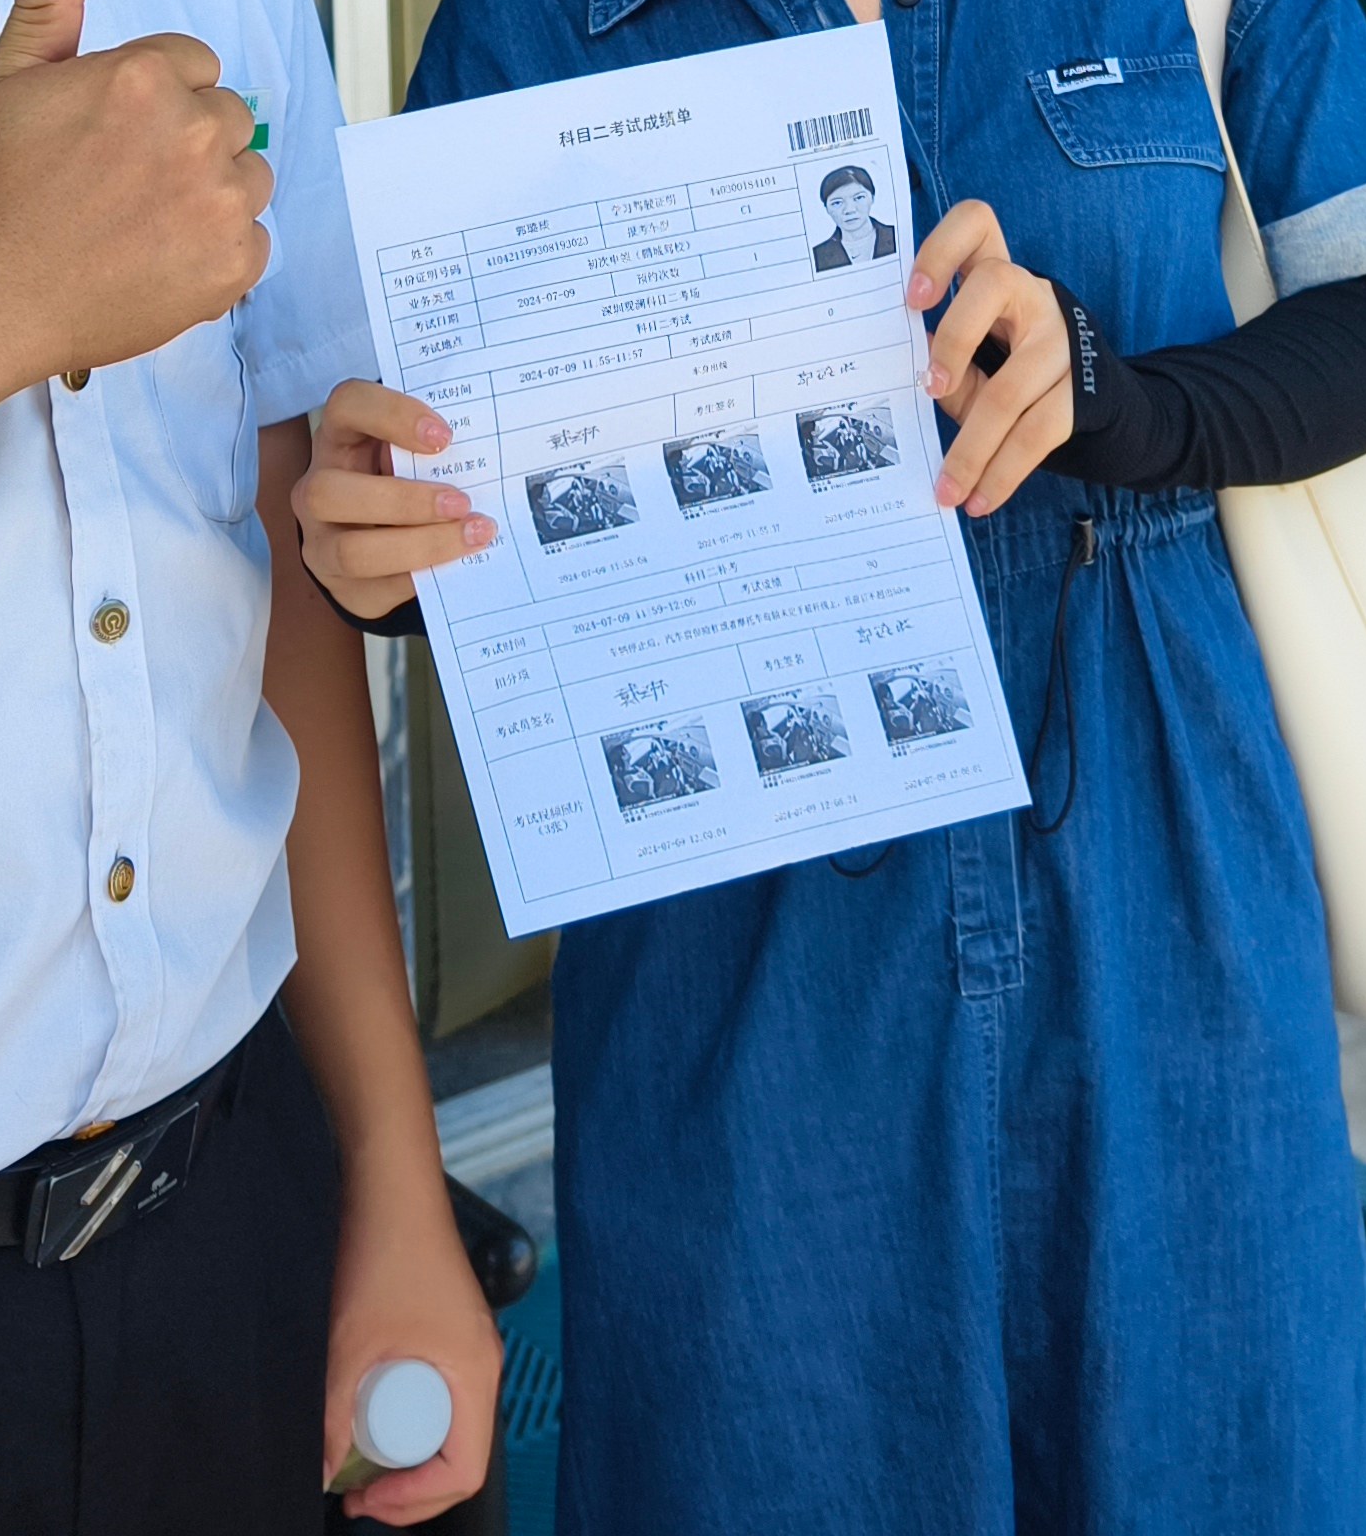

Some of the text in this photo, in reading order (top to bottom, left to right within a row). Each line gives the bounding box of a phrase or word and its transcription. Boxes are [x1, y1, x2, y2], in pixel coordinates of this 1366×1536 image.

[557, 105, 692, 148] 科目二考试成绩单
[739, 204, 751, 214] C1
[410, 245, 433, 260] 姓名
[393, 263, 461, 289] 身份证明号码
[636, 266, 679, 285] 预约次数
[408, 289, 455, 309] 业务类型
[517, 287, 575, 308] 2024-07-09
[827, 307, 833, 316] 0
[413, 312, 459, 333] 考试日期
[635, 312, 691, 335] 科目二考试
[417, 335, 463, 357] 考试地点
[688, 329, 732, 348] 考试成绩
[518, 347, 643, 383] 2024-07-09 11:55-11:57
[424, 383, 472, 403] 考试时间
[693, 398, 735, 417] 考生签名
[428, 455, 487, 479] 考试员签名
[684, 561, 738, 584] 科目二补考
[740, 575, 782, 596] 考试成绩
[572, 612, 630, 634] 2024-07-09
[478, 637, 525, 657] 考试时间
[763, 652, 804, 673] 考生签名
[494, 670, 530, 689] 扣分项
[494, 713, 554, 736] 考试员签名
[513, 799, 584, 828] 考试视频照片
